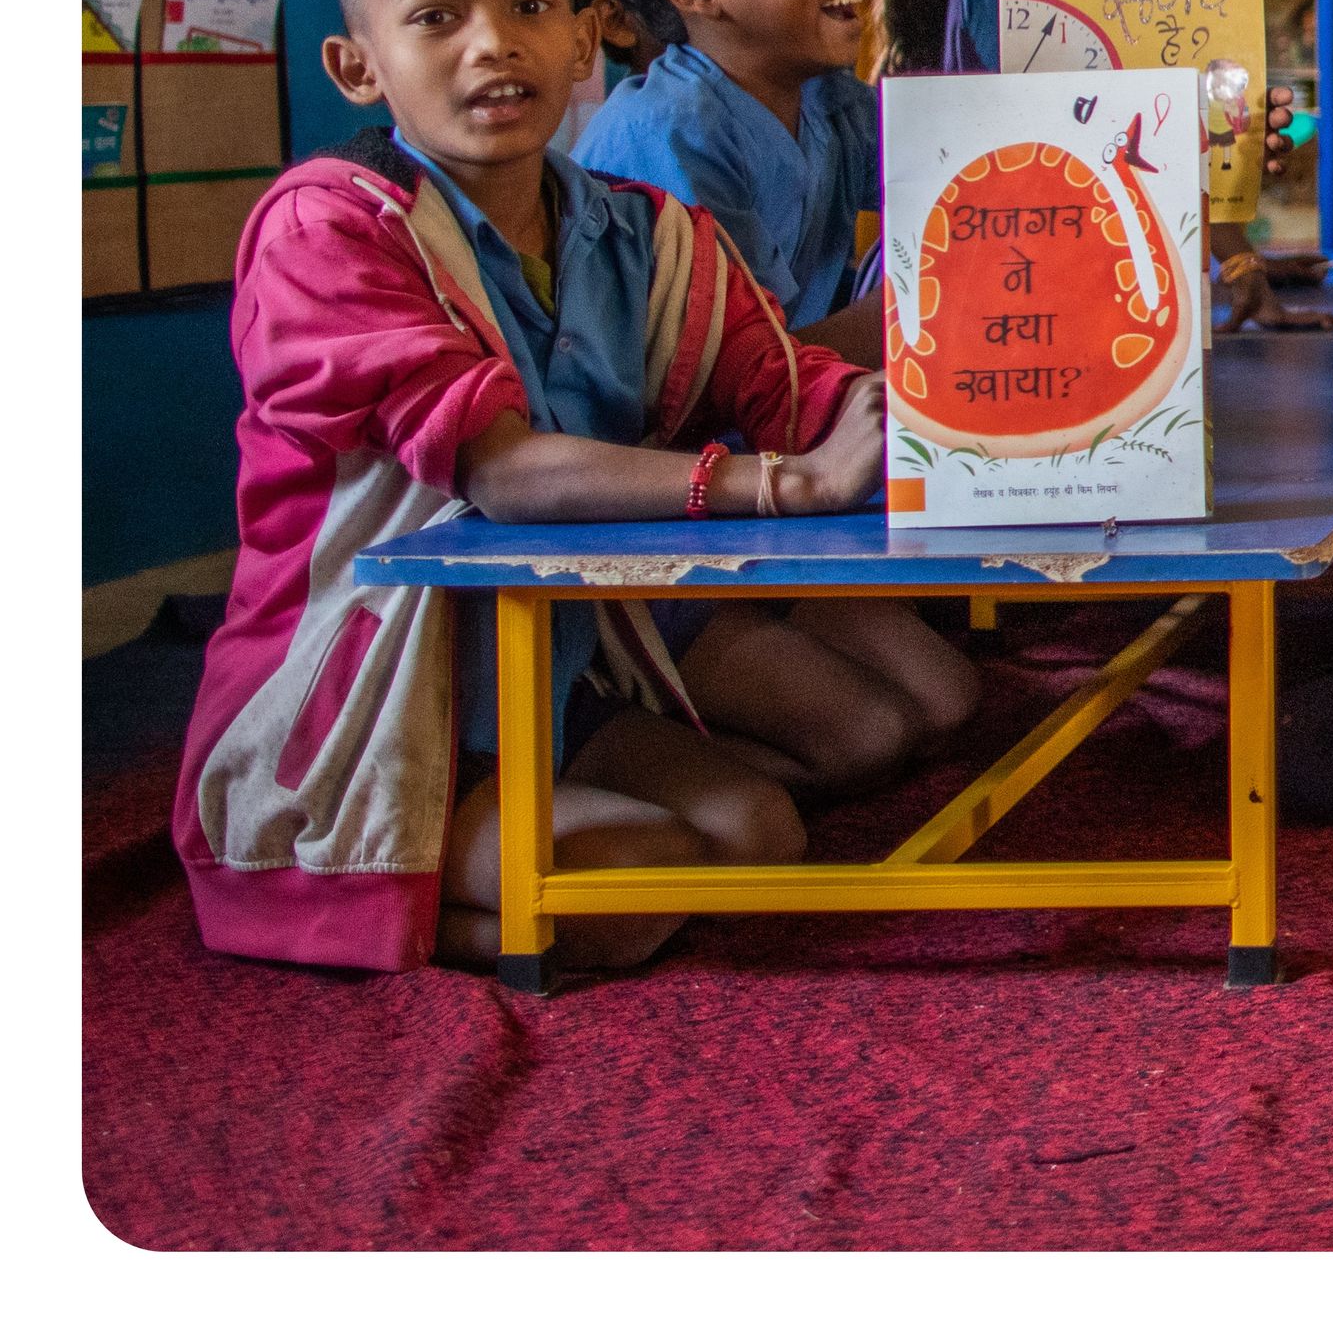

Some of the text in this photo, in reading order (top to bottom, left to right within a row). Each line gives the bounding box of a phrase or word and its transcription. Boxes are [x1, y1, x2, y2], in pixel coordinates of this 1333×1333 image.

[1005, 8, 1030, 30] 12
[1059, 22, 1067, 44] 1
[1084, 47, 1099, 69] 2
[951, 204, 1089, 242] अजगर
[1003, 246, 1036, 295] ने
[982, 312, 1057, 346] क्या
[954, 367, 1084, 403] खाया?
[972, 487, 995, 498] लेखक
[1077, 483, 1093, 495] किम
